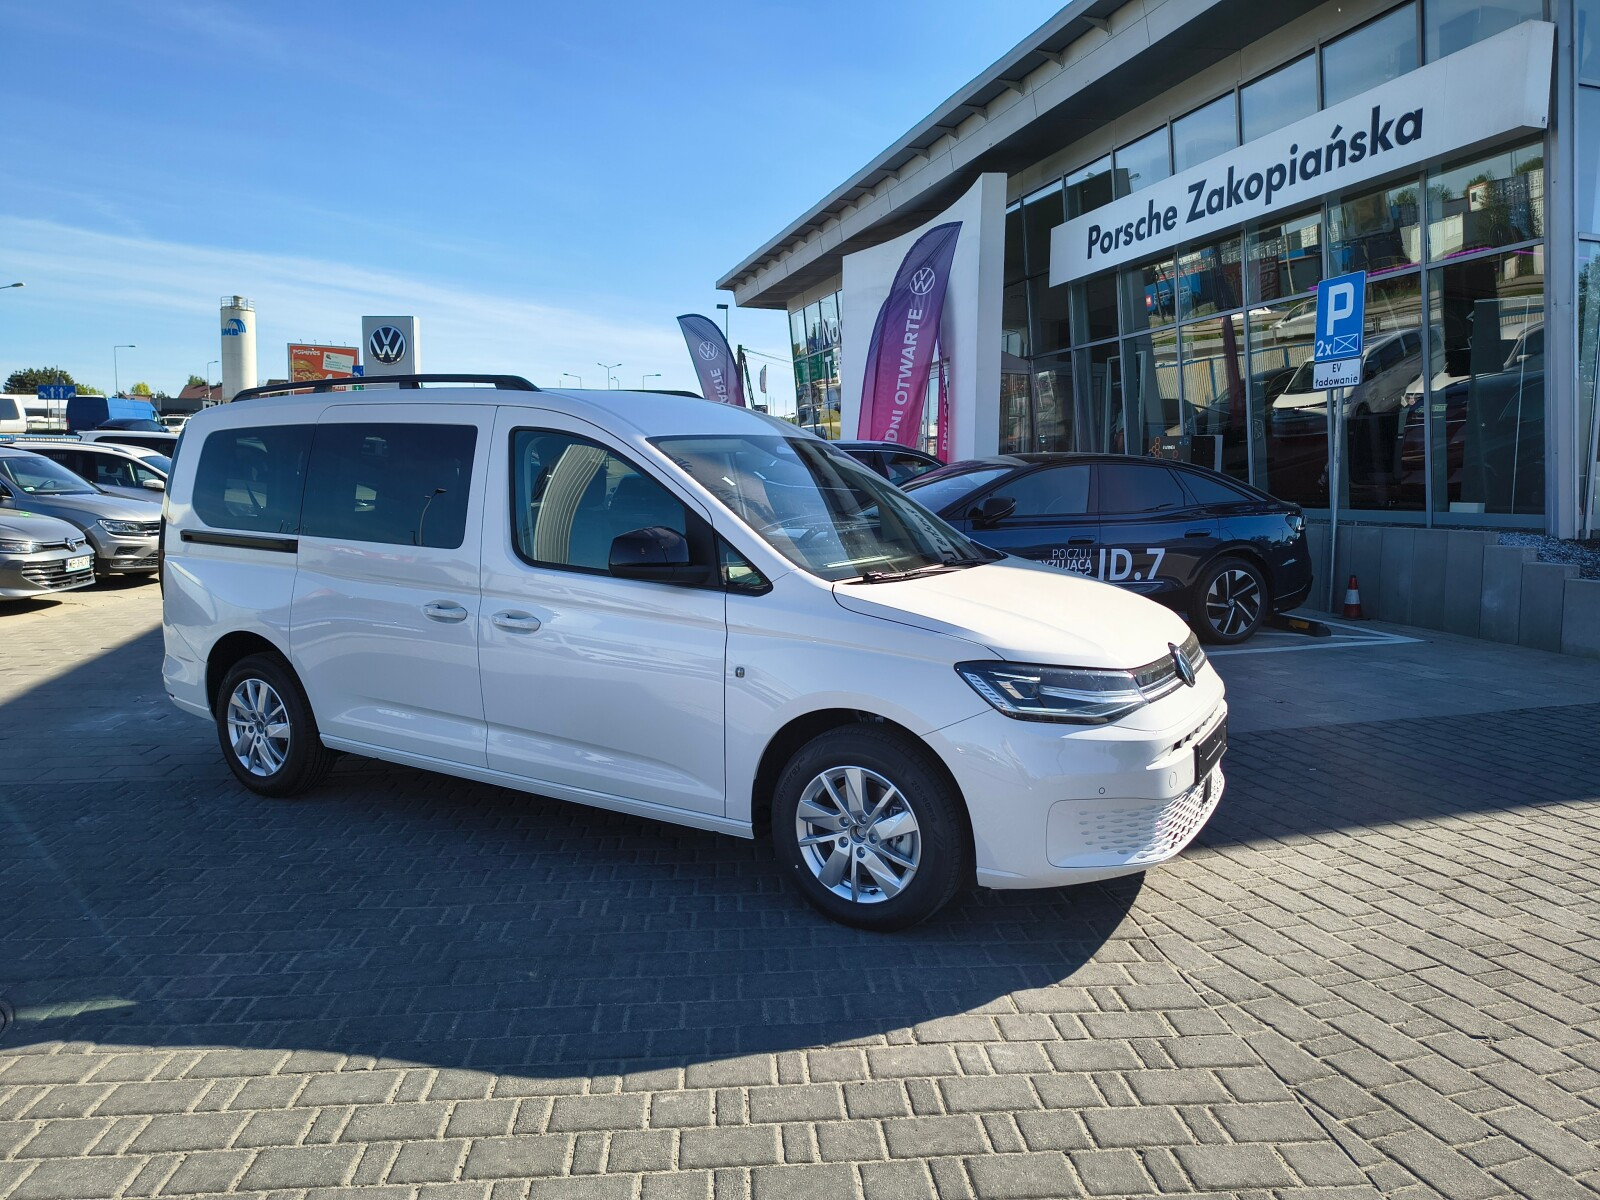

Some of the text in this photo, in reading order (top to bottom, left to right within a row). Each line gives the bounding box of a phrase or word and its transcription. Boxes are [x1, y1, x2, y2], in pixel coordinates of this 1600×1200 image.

[1087, 104, 1424, 260] Porsche Zakopiańska
[1326, 282, 1354, 336] P
[1316, 340, 1332, 357] 2x
[885, 308, 923, 442] DNI OTWARTE
[1332, 363, 1342, 373] EV
[1315, 374, 1358, 387] ładowanie
[1052, 548, 1092, 560] POCZUJ
[1036, 559, 1092, 573] YZUJĄCĄ
[1098, 548, 1165, 580] ID.7
